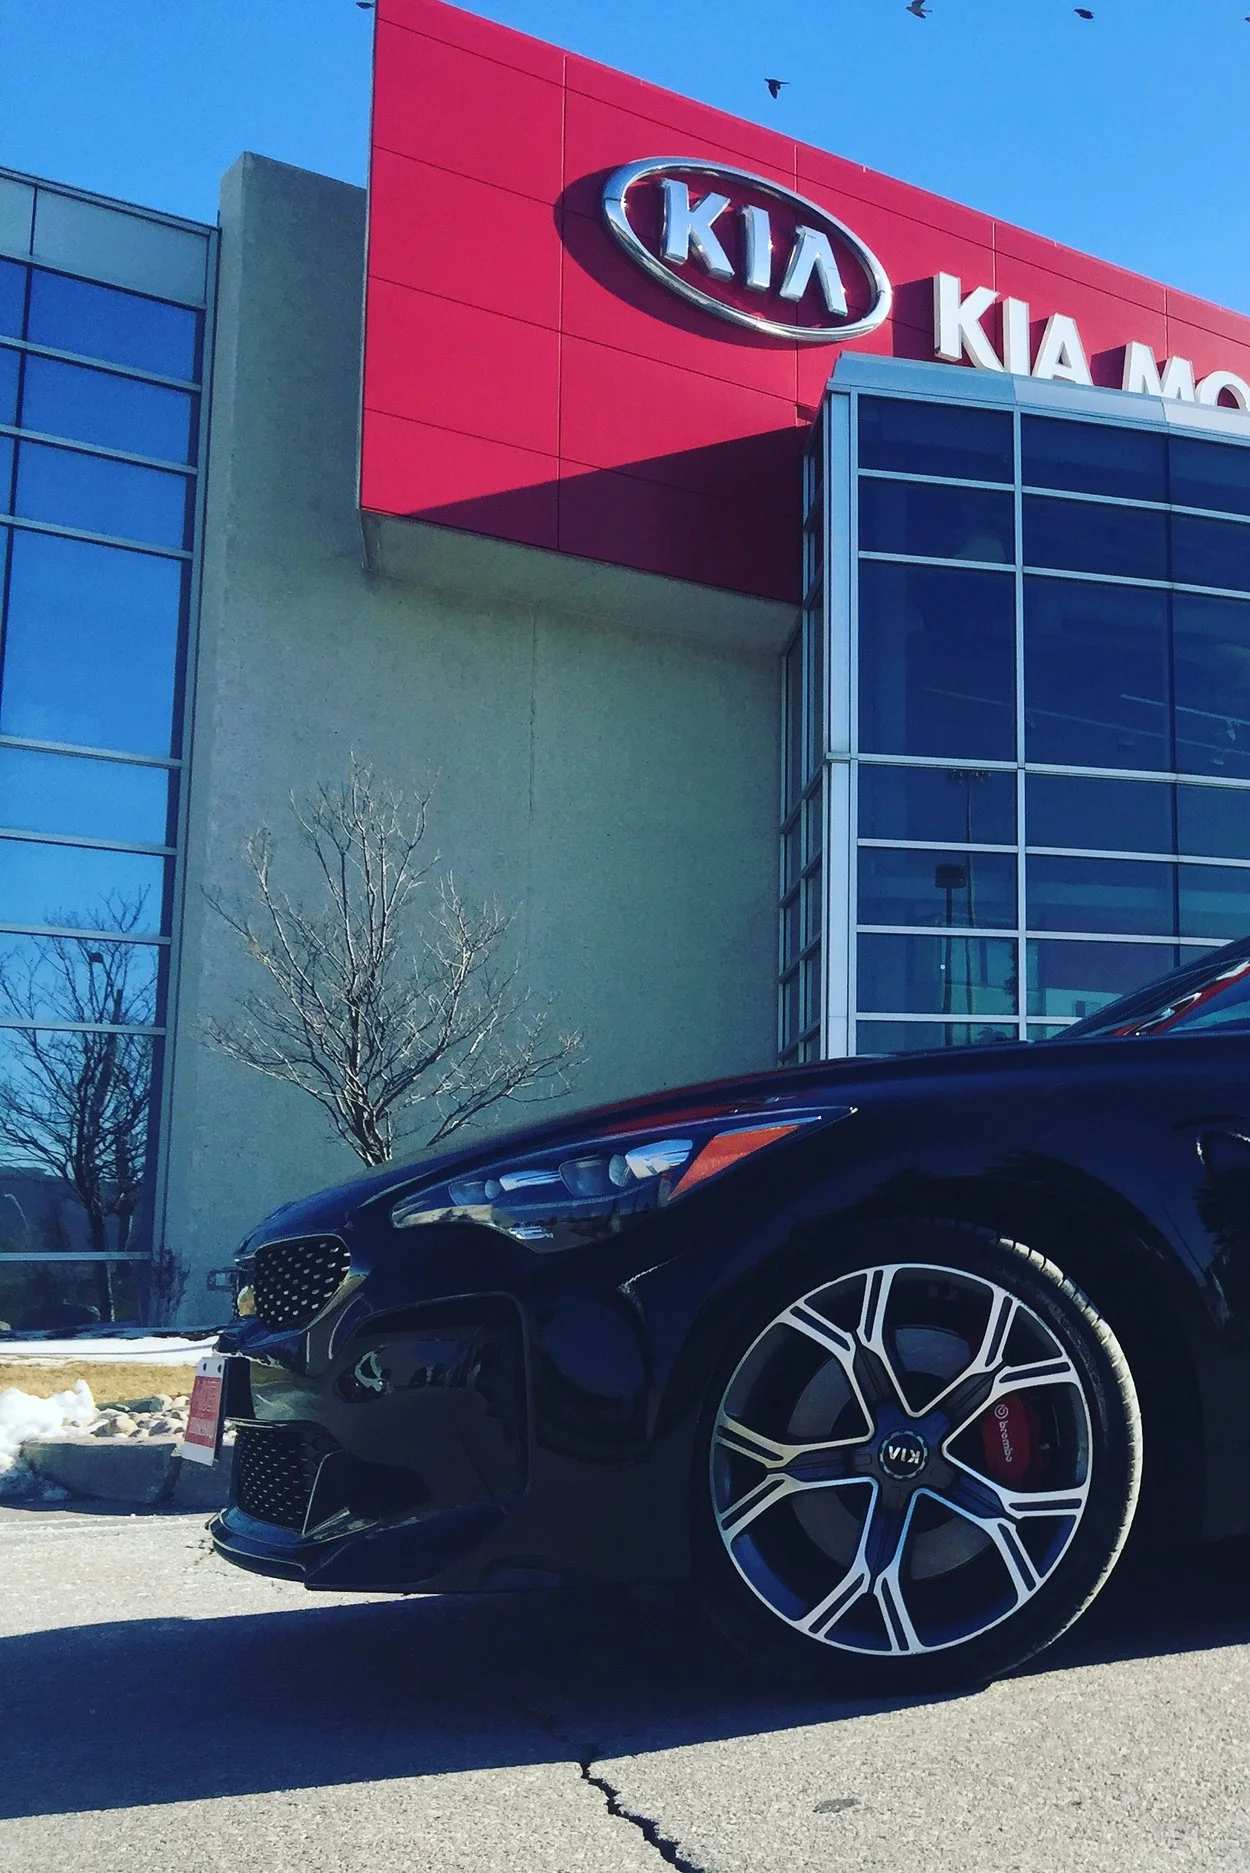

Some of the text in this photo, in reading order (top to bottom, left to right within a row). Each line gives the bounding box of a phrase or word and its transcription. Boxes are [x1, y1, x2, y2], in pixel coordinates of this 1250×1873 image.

[660, 178, 848, 317] KIA
[933, 271, 1094, 386] KIA
[888, 1446, 921, 1465] KIA
[999, 1420, 1013, 1463] brembo
